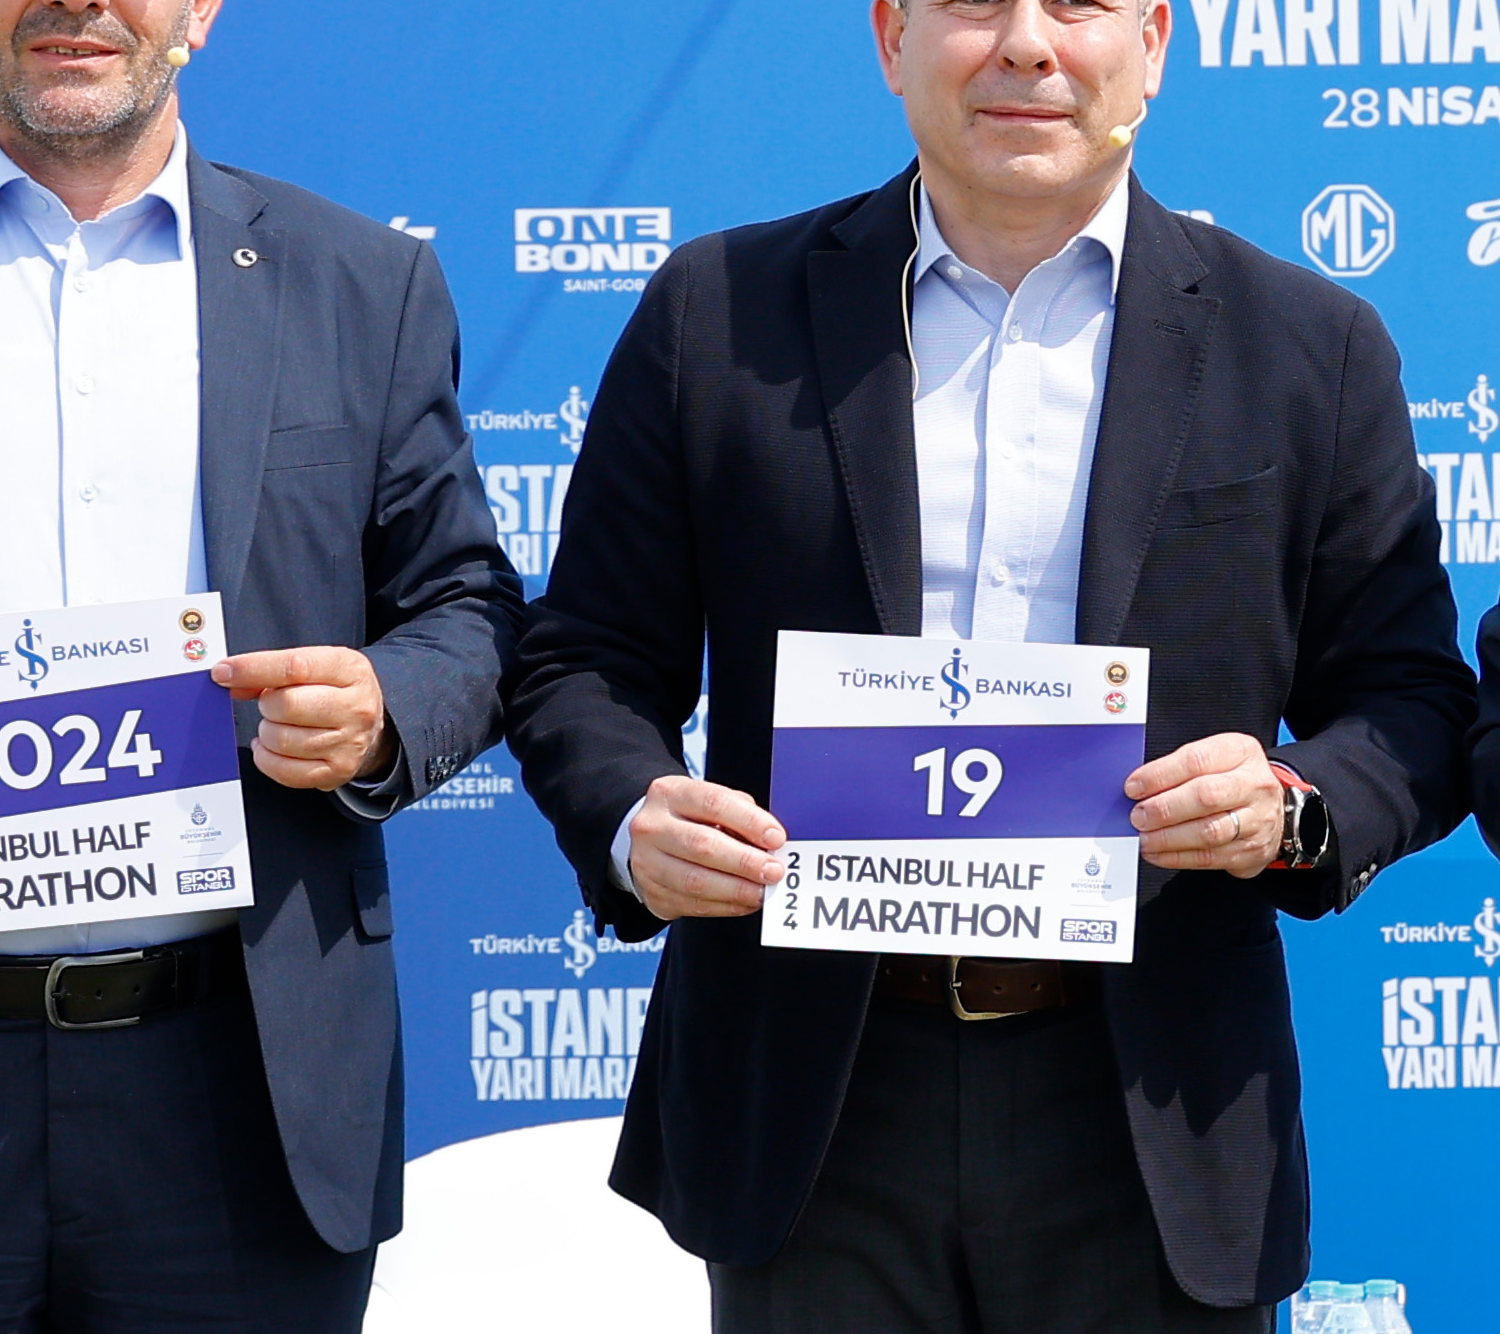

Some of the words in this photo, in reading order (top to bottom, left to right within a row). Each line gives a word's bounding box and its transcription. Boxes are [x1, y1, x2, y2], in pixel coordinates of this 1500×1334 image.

[1322, 88, 1380, 128] 28
[526, 214, 660, 241] ONE
[1310, 192, 1387, 269] MG
[516, 243, 672, 273] BOND
[563, 278, 646, 292] SAINT-GOB
[466, 410, 558, 430] TÜRKİYE
[1408, 398, 1465, 418] RKİYE
[52, 637, 150, 662] BANKASI
[838, 668, 935, 692] TÜRKİYE
[975, 678, 1072, 699] BANKASI
[430, 774, 515, 795] KŞEHİR
[913, 747, 1003, 817] 19
[73, 821, 151, 857] HALF
[180, 869, 231, 884] SPOR
[816, 854, 959, 887] ISTANBUL
[967, 862, 1045, 891] HALF
[812, 897, 1041, 938] MARATHON
[1063, 920, 1113, 934] SPOR
[1380, 922, 1472, 943] TÜRKİYE
[469, 934, 562, 954] TÜRKİYE
[597, 935, 667, 953] BANKA
[471, 988, 653, 1058] İSTANB
[470, 1058, 545, 1101] YARI
[1382, 1046, 1456, 1089] YARI
